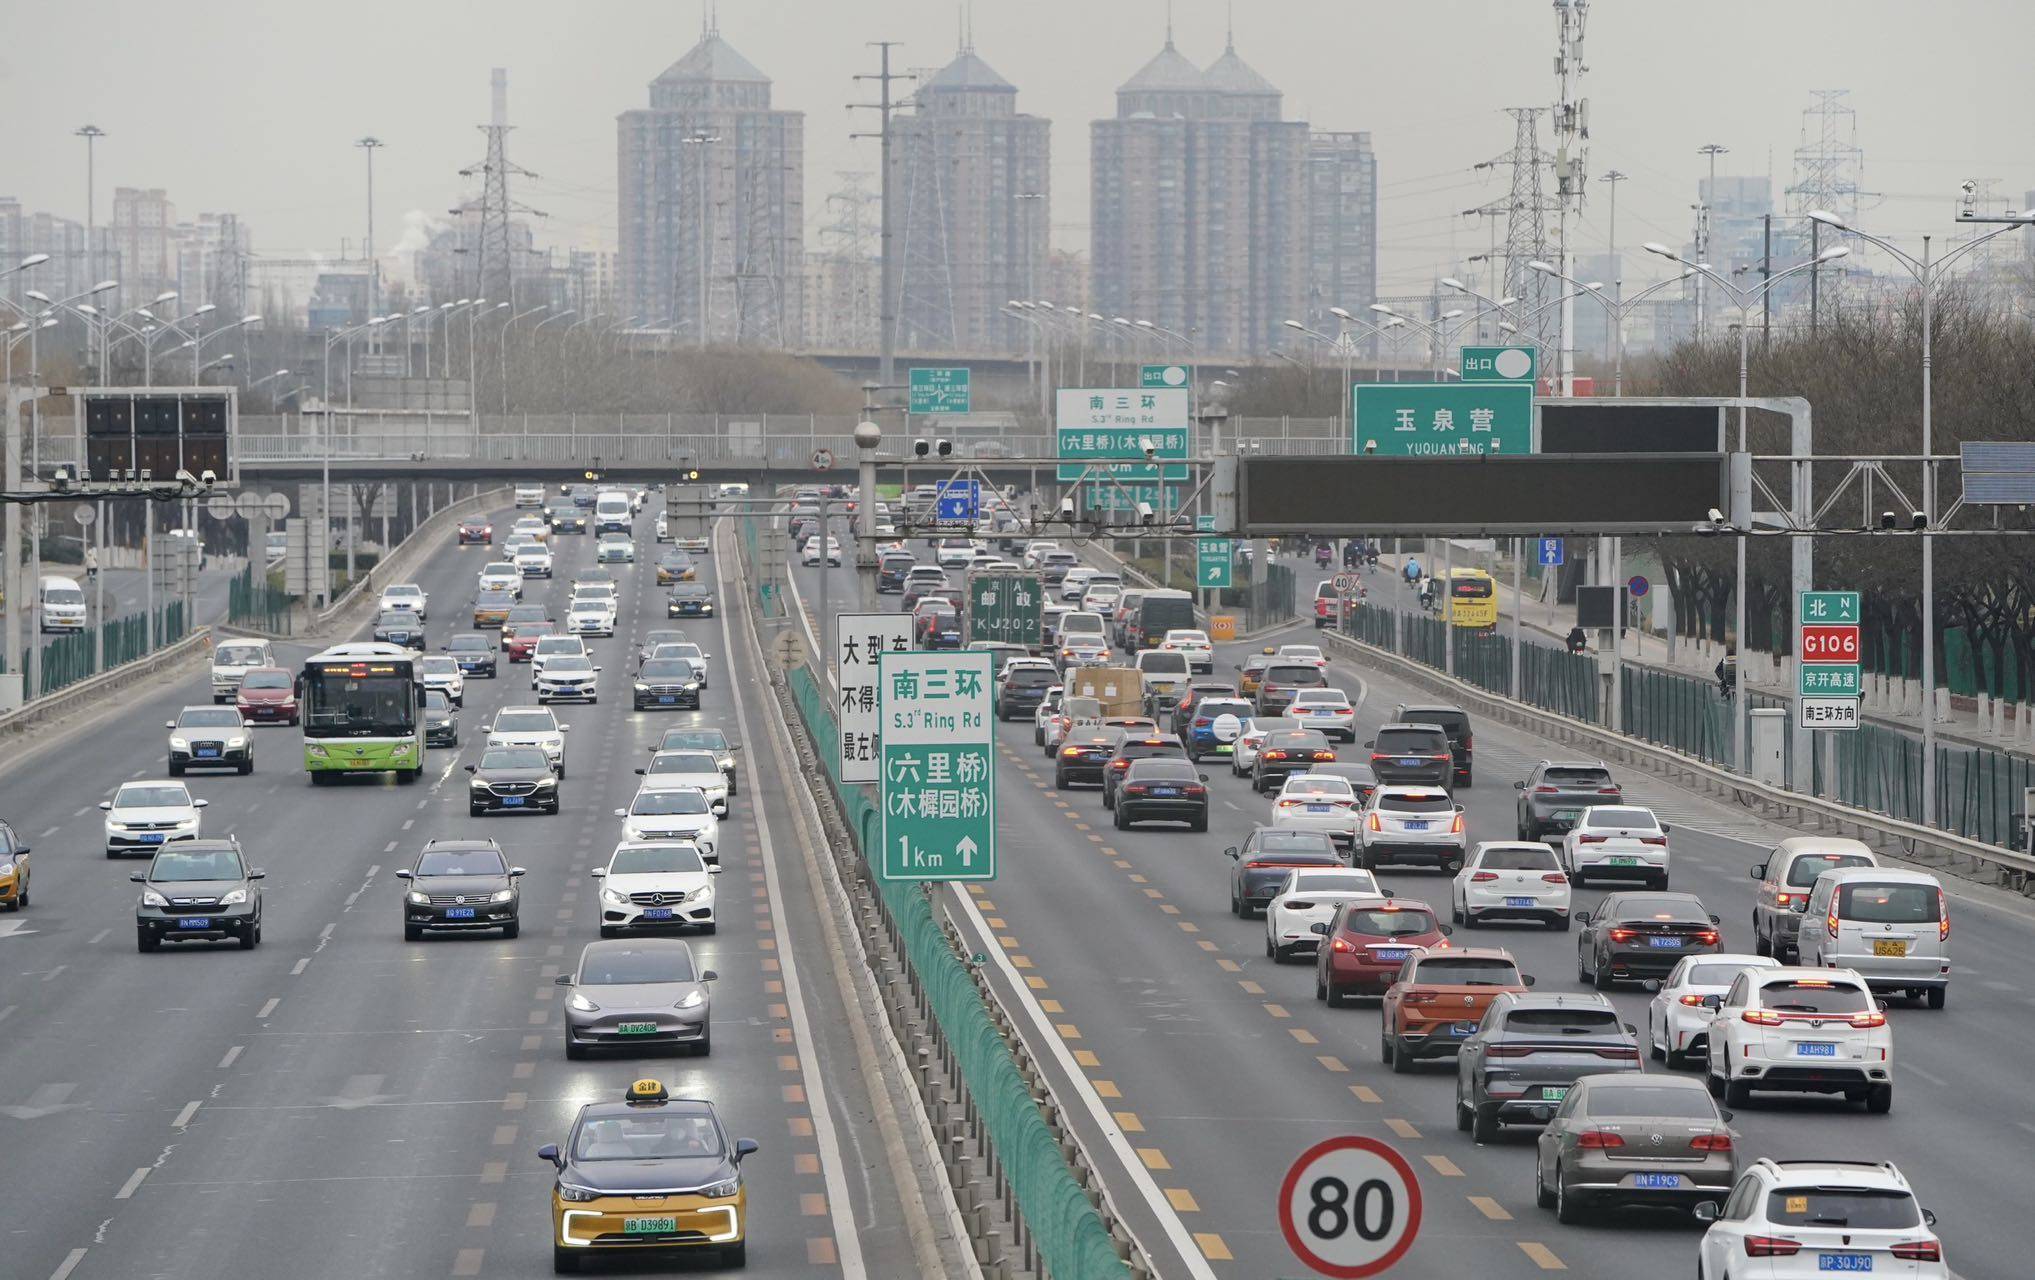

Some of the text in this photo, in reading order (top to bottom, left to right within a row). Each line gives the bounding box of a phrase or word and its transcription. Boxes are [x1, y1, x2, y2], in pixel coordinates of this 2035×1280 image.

[1464, 358, 1492, 370] 出口
[1144, 372, 1161, 380] 出口
[1089, 395, 1155, 409] 南三环
[1115, 415, 1136, 425] Ring
[1141, 415, 1154, 424] Rd
[1394, 408, 1494, 432] 玉泉营
[1406, 442, 1484, 454] YUQUANYNG
[1335, 578, 1347, 588] 40
[981, 591, 1032, 607] 邮政
[1809, 597, 1850, 617] 北 N
[977, 618, 1034, 630] KJ202
[1805, 635, 1855, 653] G106
[892, 669, 982, 701] 南三环
[1805, 672, 1855, 688] 京开高速
[842, 685, 880, 713] 不得
[1805, 706, 1855, 721] 南三环方向
[924, 712, 955, 732] Ring
[963, 712, 981, 728] Rd
[887, 752, 988, 783] (六里桥)
[1308, 1176, 1394, 1242] 80
